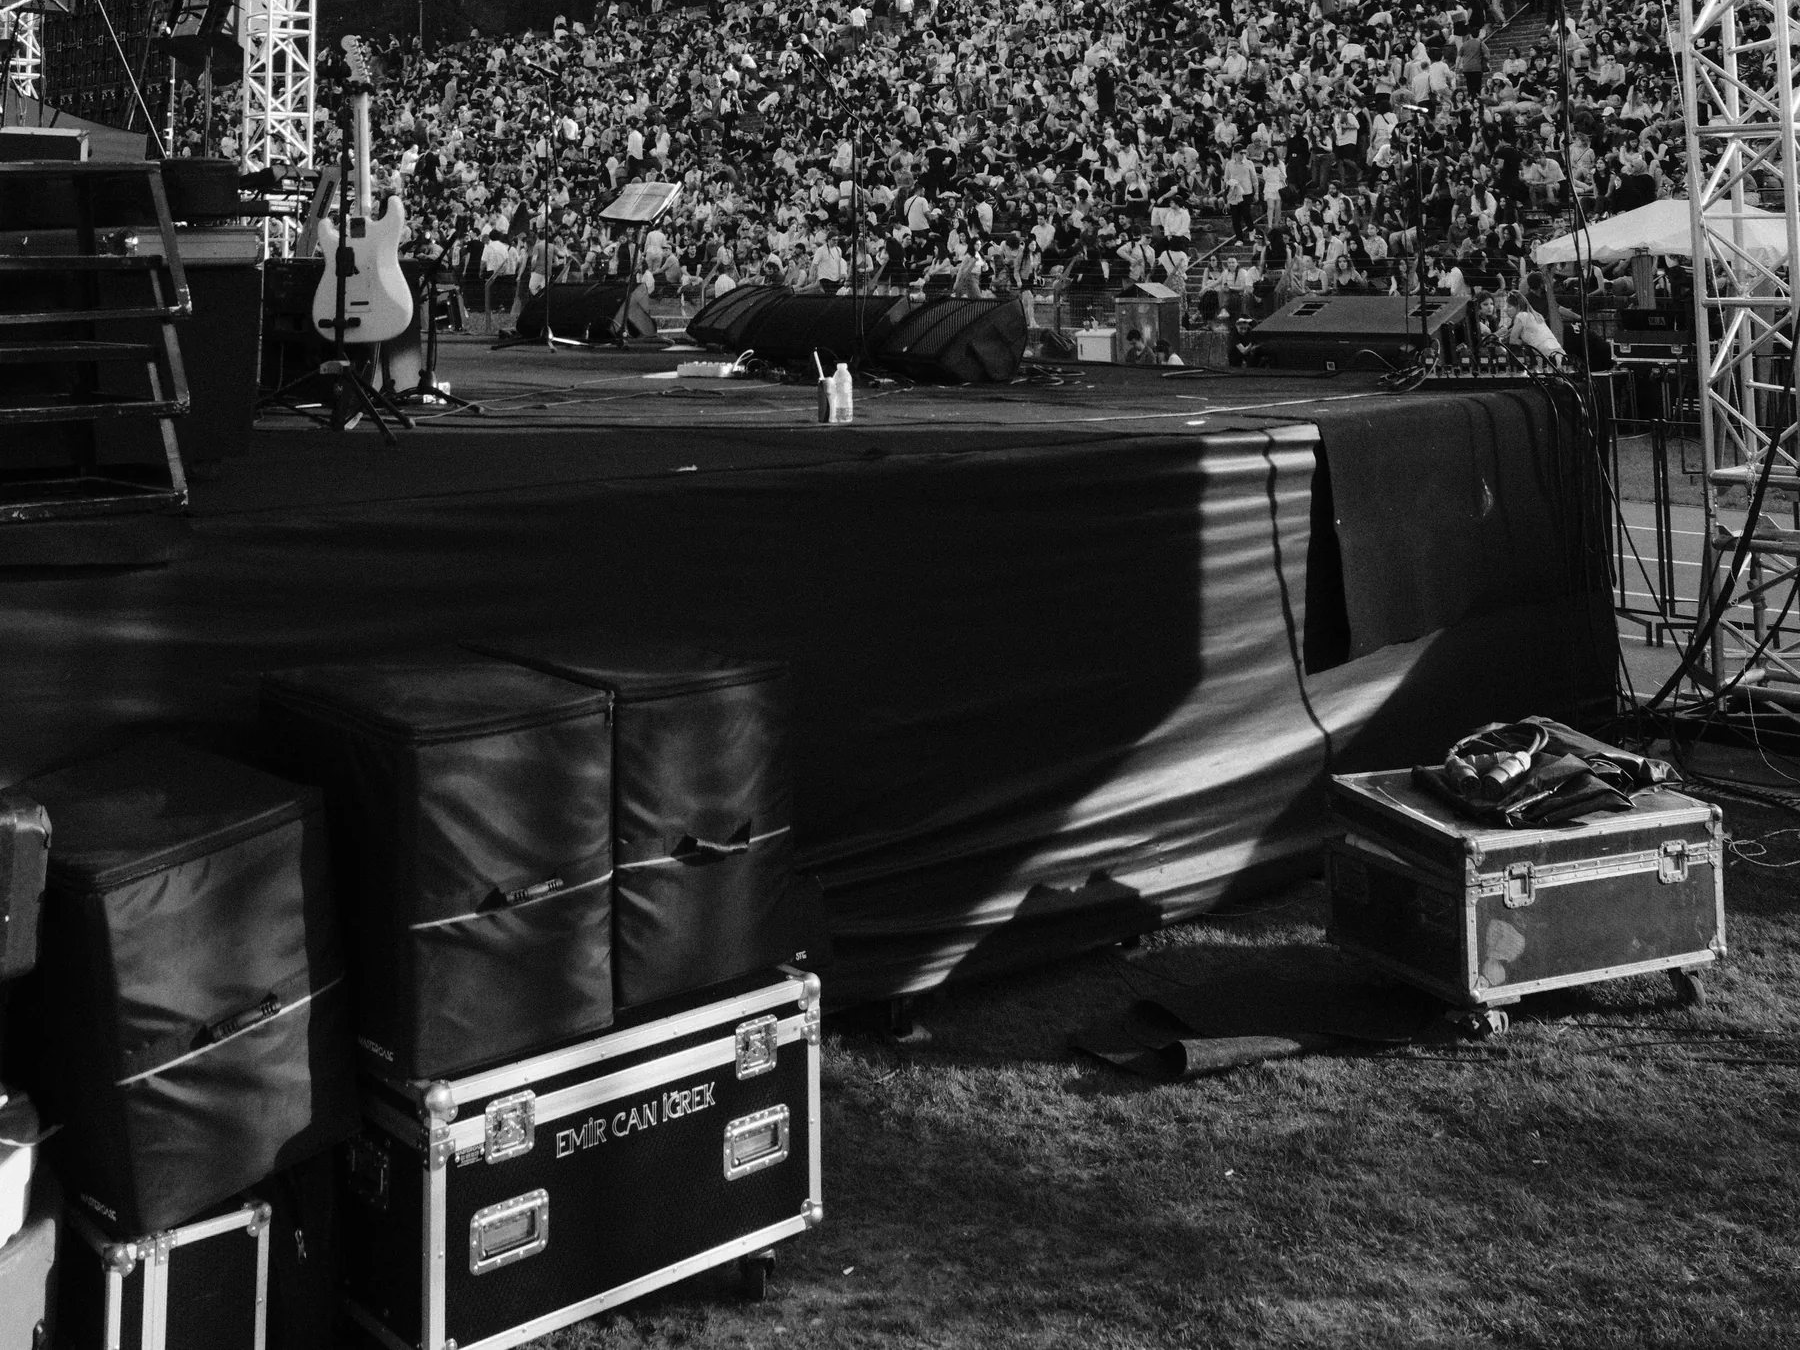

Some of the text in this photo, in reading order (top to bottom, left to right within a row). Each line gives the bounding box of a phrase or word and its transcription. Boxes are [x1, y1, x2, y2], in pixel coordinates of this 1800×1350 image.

[556, 1082, 716, 1158] EMİR CAN İĞREK
